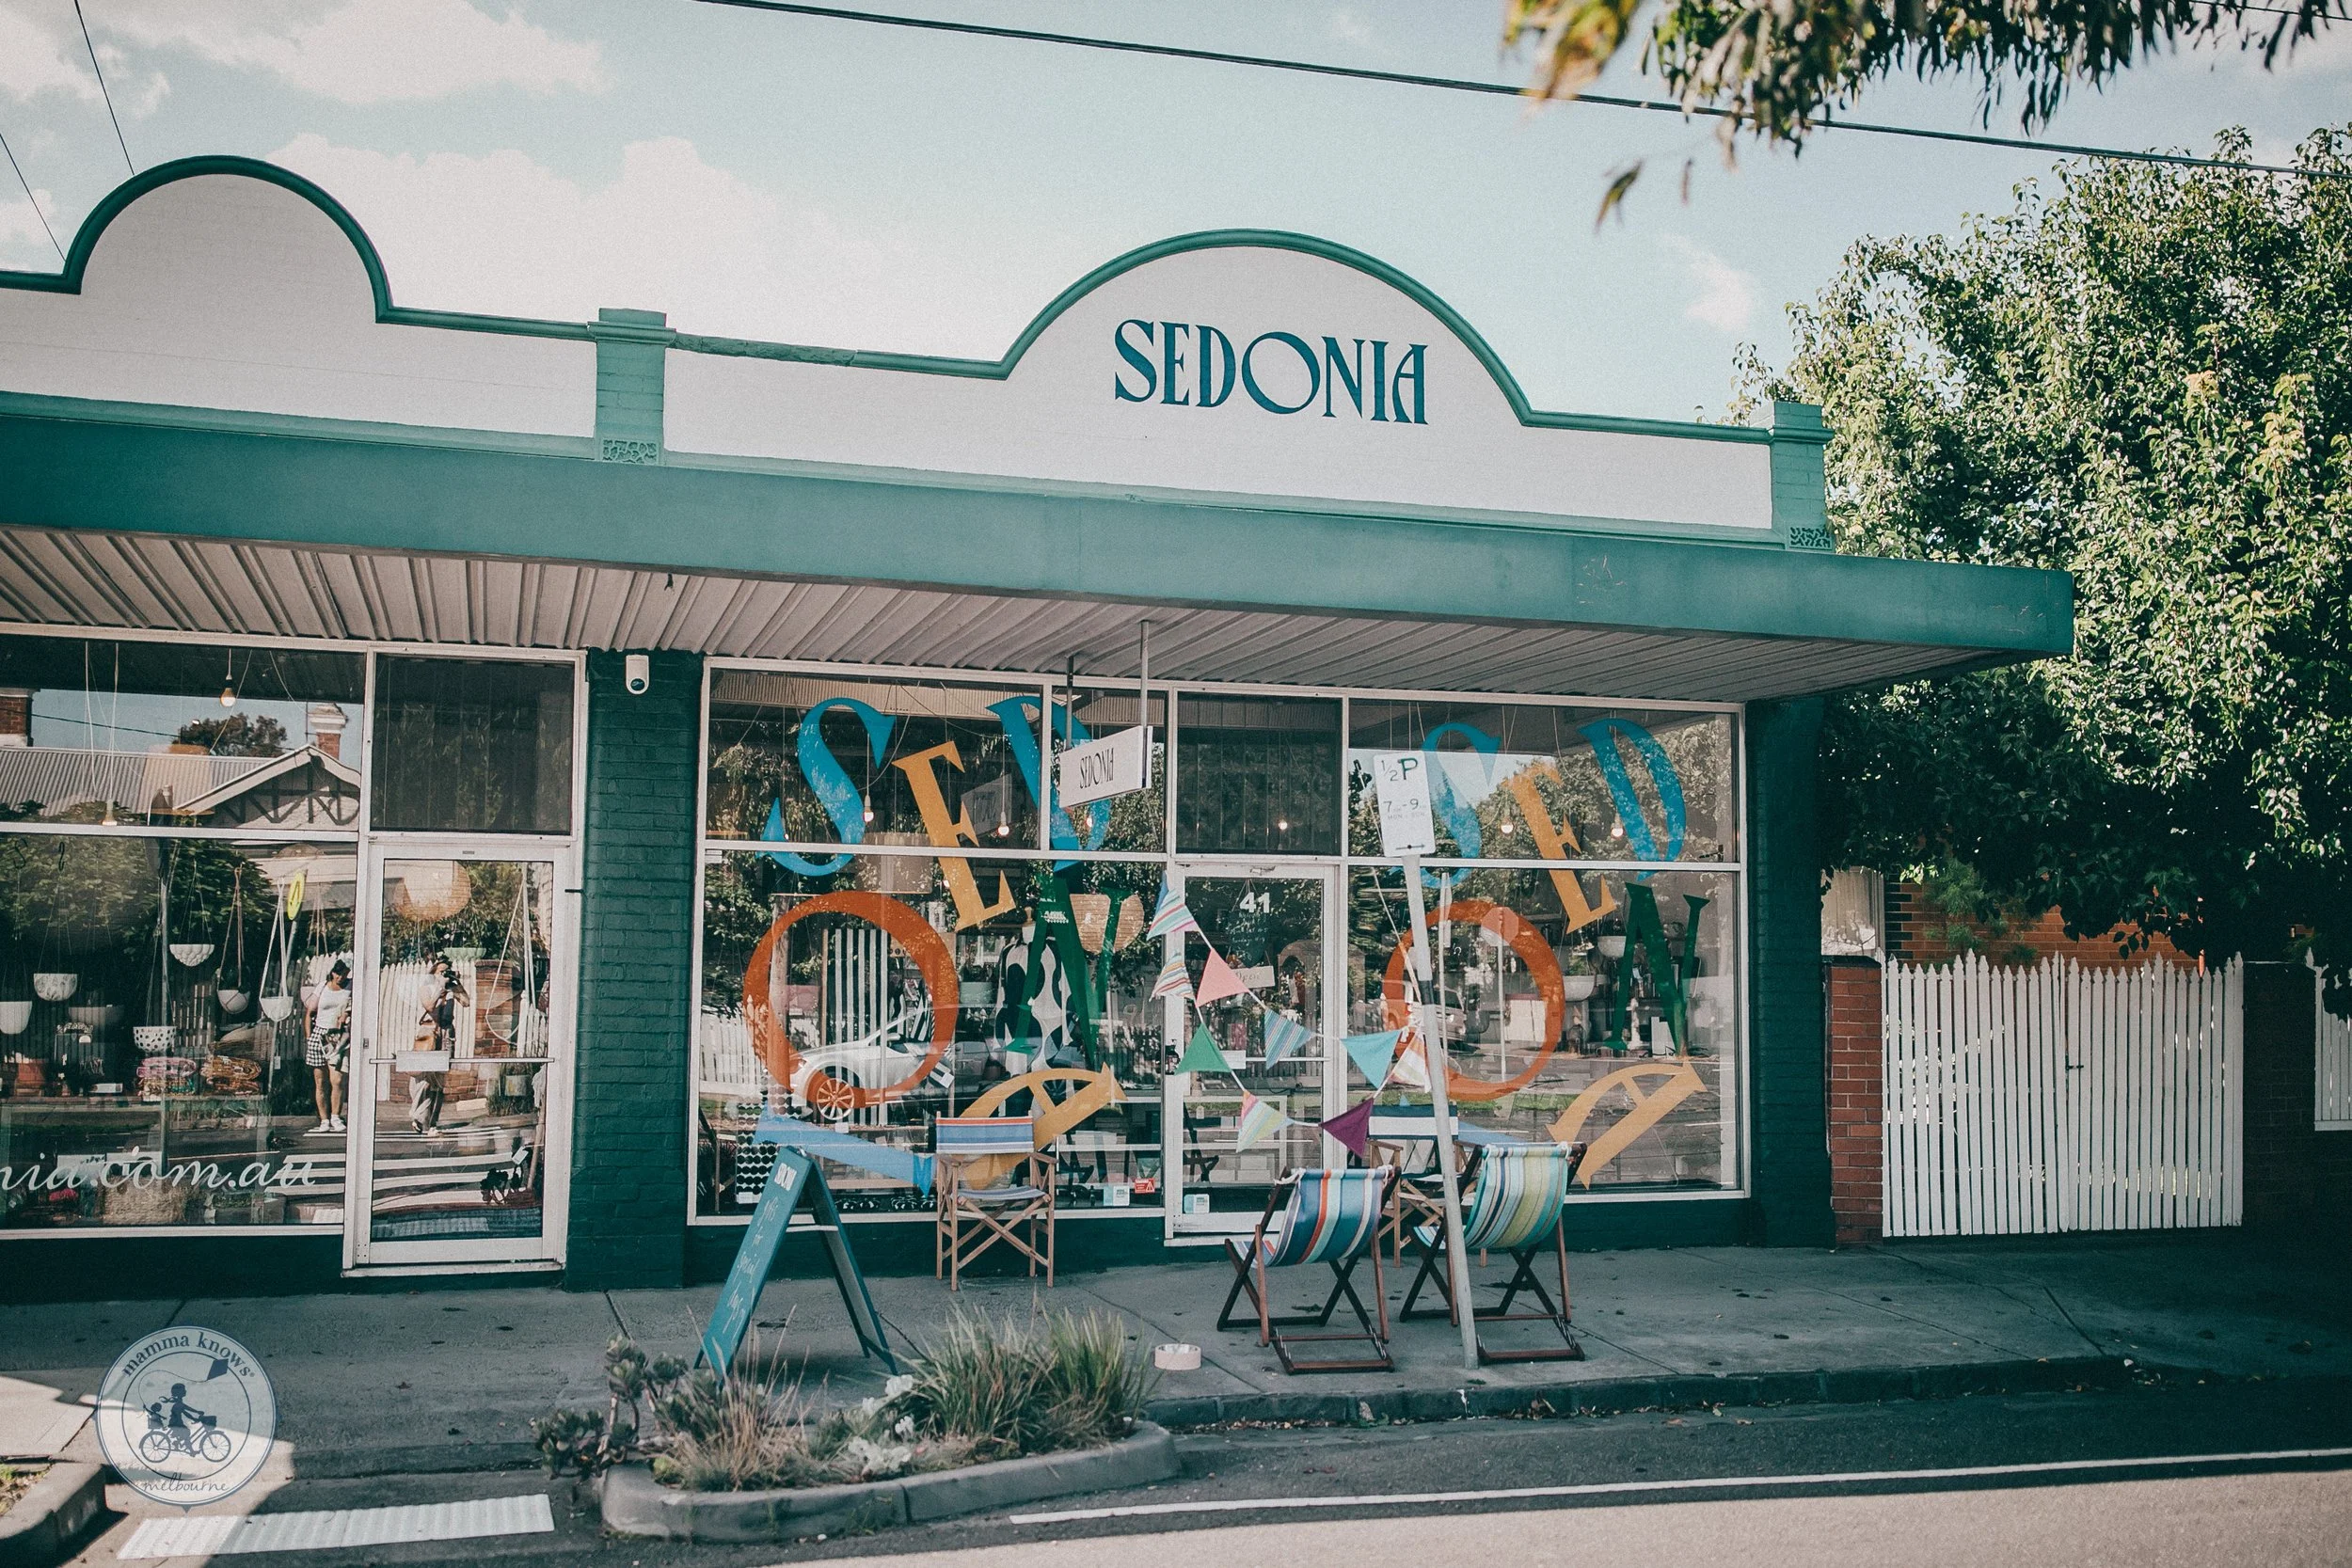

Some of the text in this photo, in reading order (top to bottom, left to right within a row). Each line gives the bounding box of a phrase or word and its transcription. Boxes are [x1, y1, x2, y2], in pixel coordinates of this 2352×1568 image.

[1114, 319, 1429, 425] SEDONIA
[1079, 747, 1114, 789] SEDONIA
[1239, 892, 1270, 913] 41
